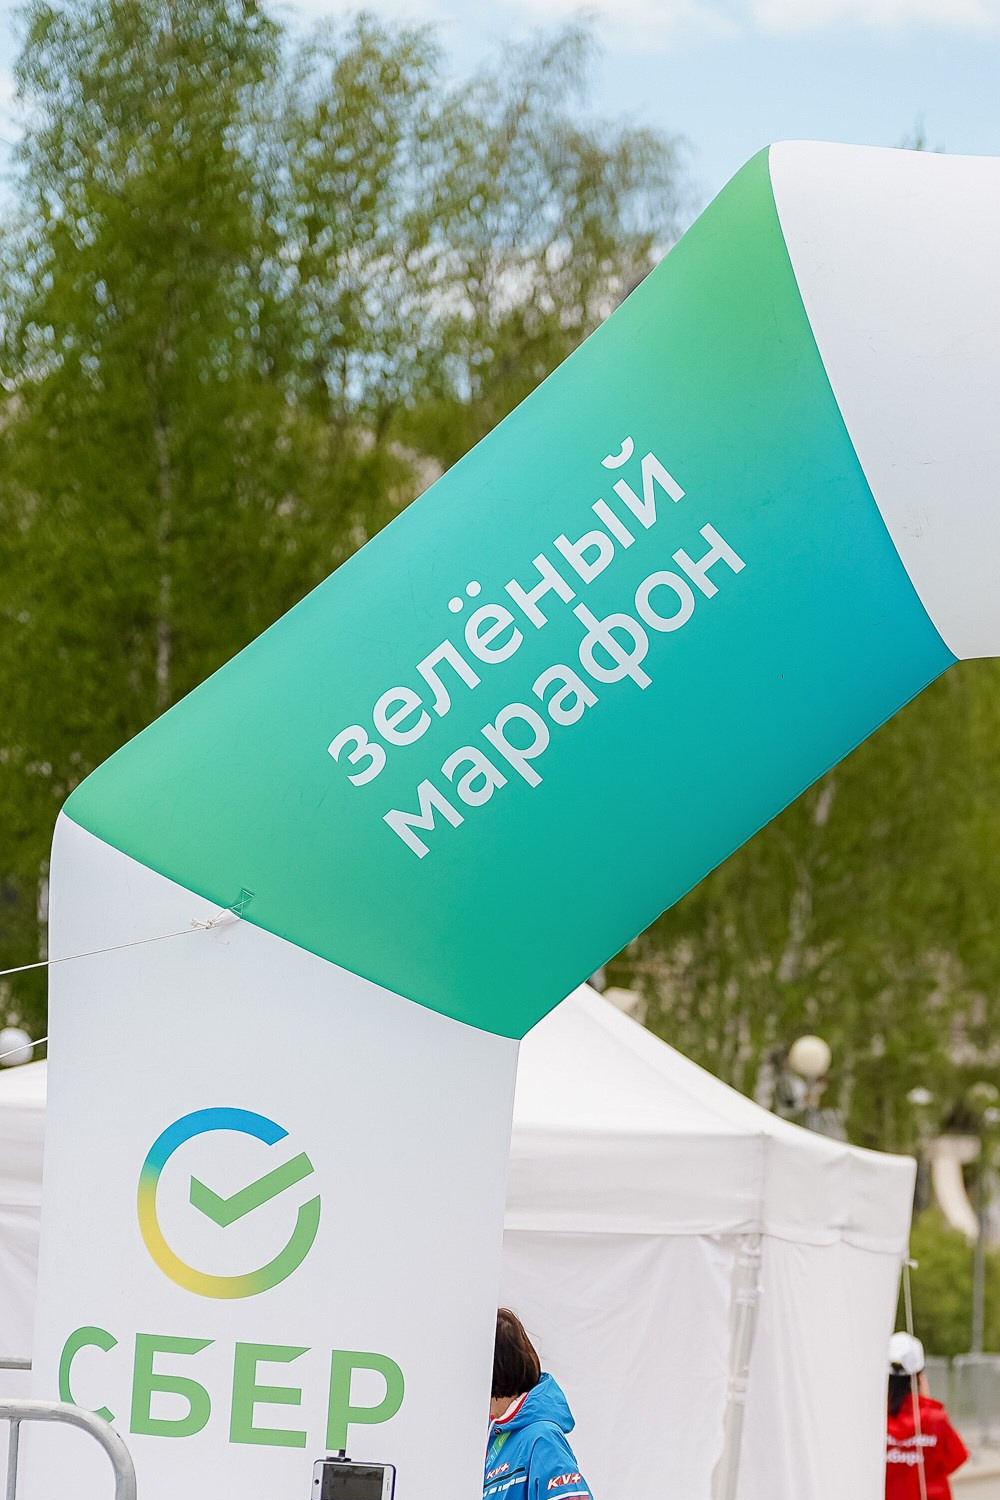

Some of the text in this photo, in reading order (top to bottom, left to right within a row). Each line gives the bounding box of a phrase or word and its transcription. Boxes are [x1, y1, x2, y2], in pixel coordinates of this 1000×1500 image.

[327, 436, 686, 787] зелёный
[383, 523, 747, 859] марафон
[59, 1326, 405, 1450] СБЕР
[547, 1473, 582, 1490] KV+
